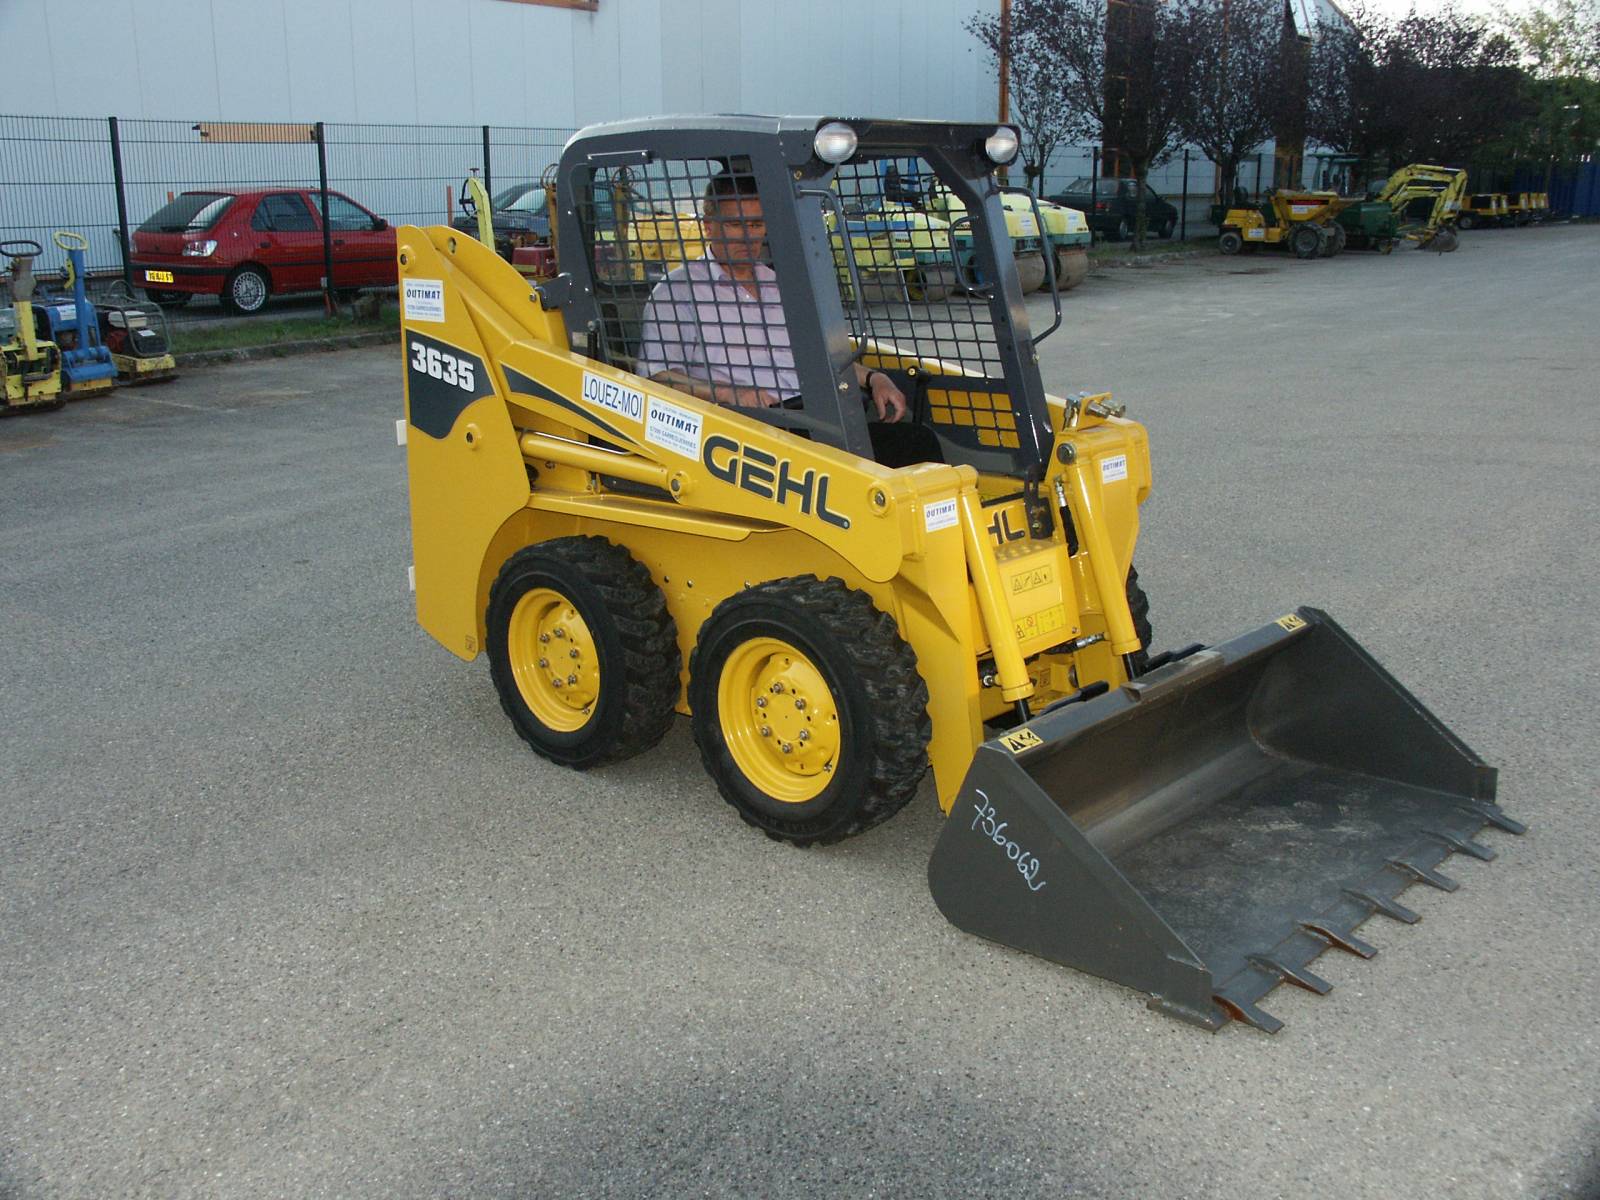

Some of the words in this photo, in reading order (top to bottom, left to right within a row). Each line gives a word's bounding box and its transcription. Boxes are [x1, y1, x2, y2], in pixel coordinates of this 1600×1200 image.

[406, 288, 441, 300] OUTIMAT
[411, 341, 475, 393] 3635
[584, 375, 643, 418] LOUEZ-MOI
[651, 409, 699, 435] OUTIMAT
[703, 435, 851, 530] GEHL
[926, 503, 956, 518] OUTIMAT
[971, 788, 1047, 891] 736062
